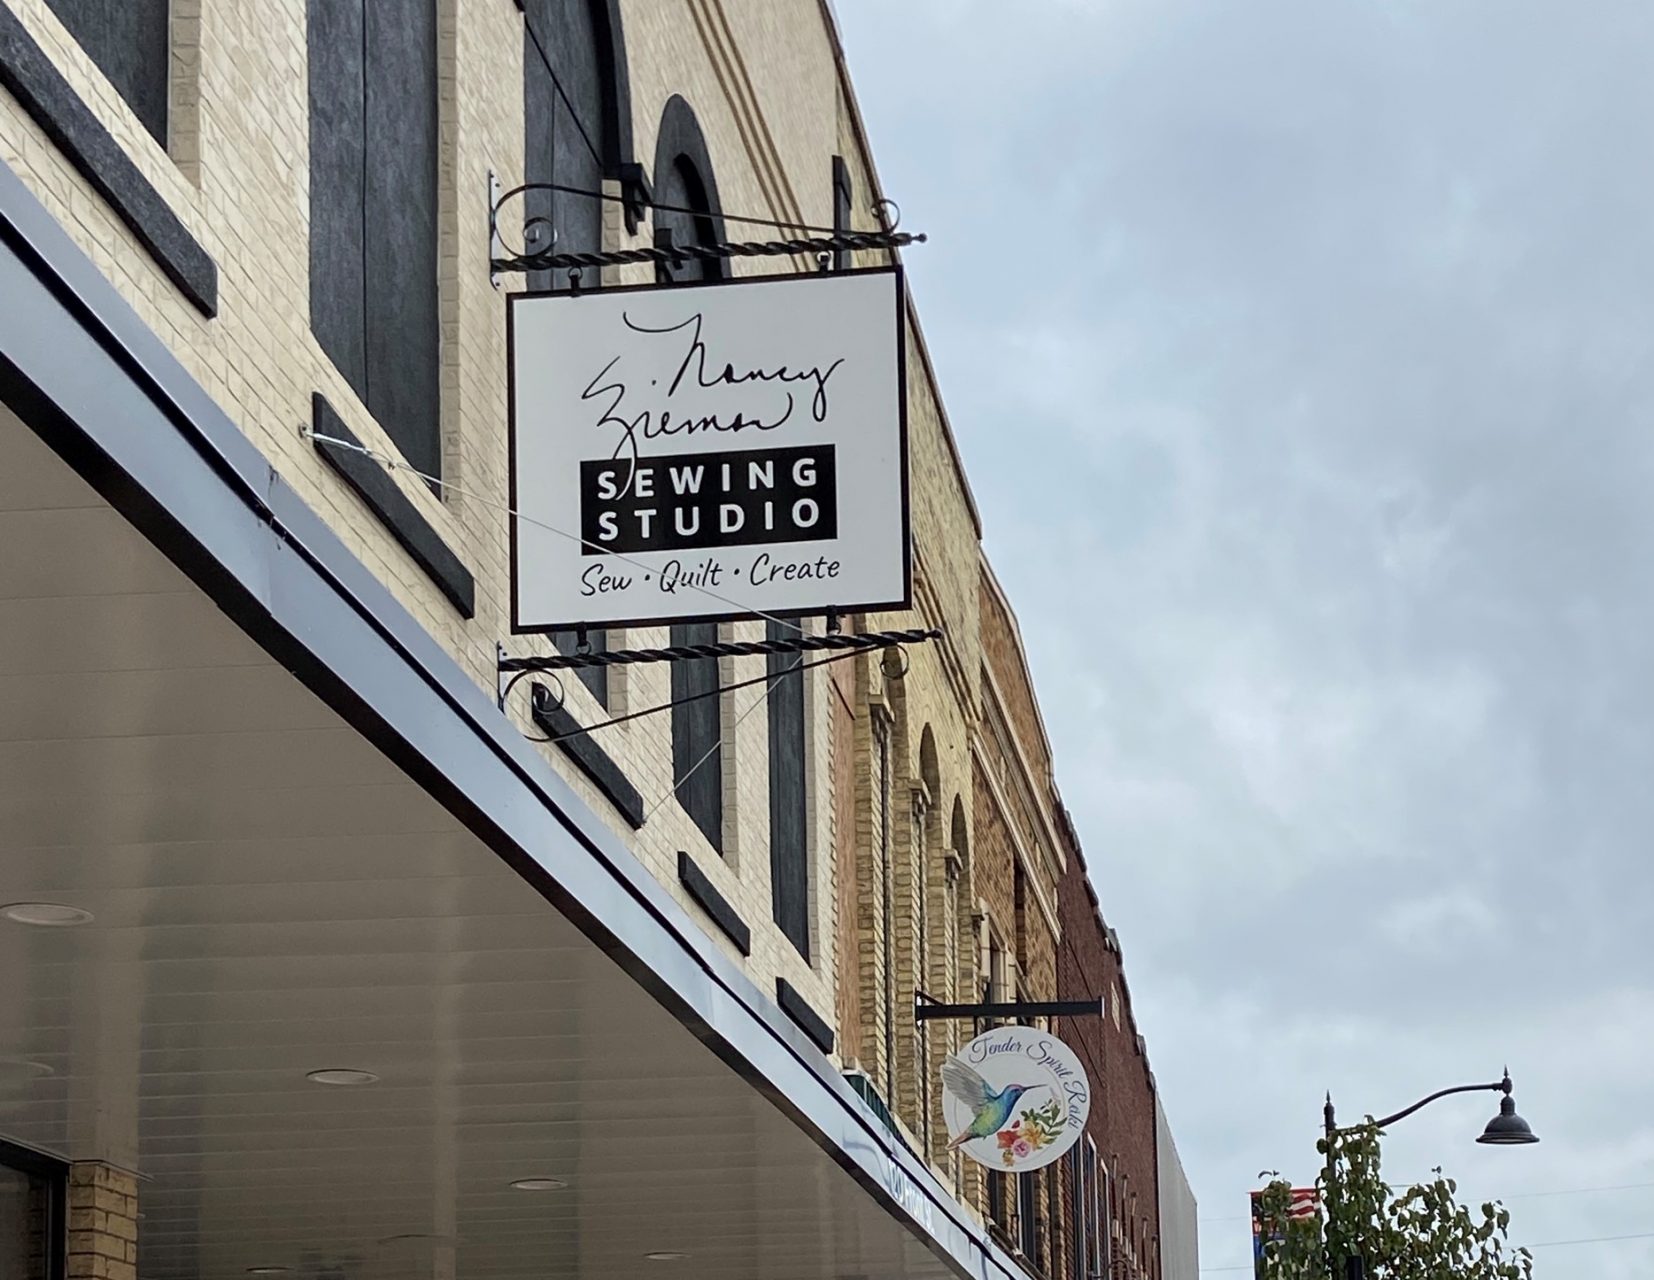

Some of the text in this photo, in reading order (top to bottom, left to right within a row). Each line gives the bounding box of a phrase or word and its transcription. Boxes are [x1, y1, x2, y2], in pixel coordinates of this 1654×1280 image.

[623, 311, 845, 423] Nancy
[581, 355, 793, 501] Zieman
[597, 457, 818, 500] SEWING
[598, 499, 820, 541] STUDIO
[580, 553, 840, 597] Sew Quilt Create
[968, 1036, 1023, 1063] Tender
[1026, 1040, 1073, 1079] Spirit
